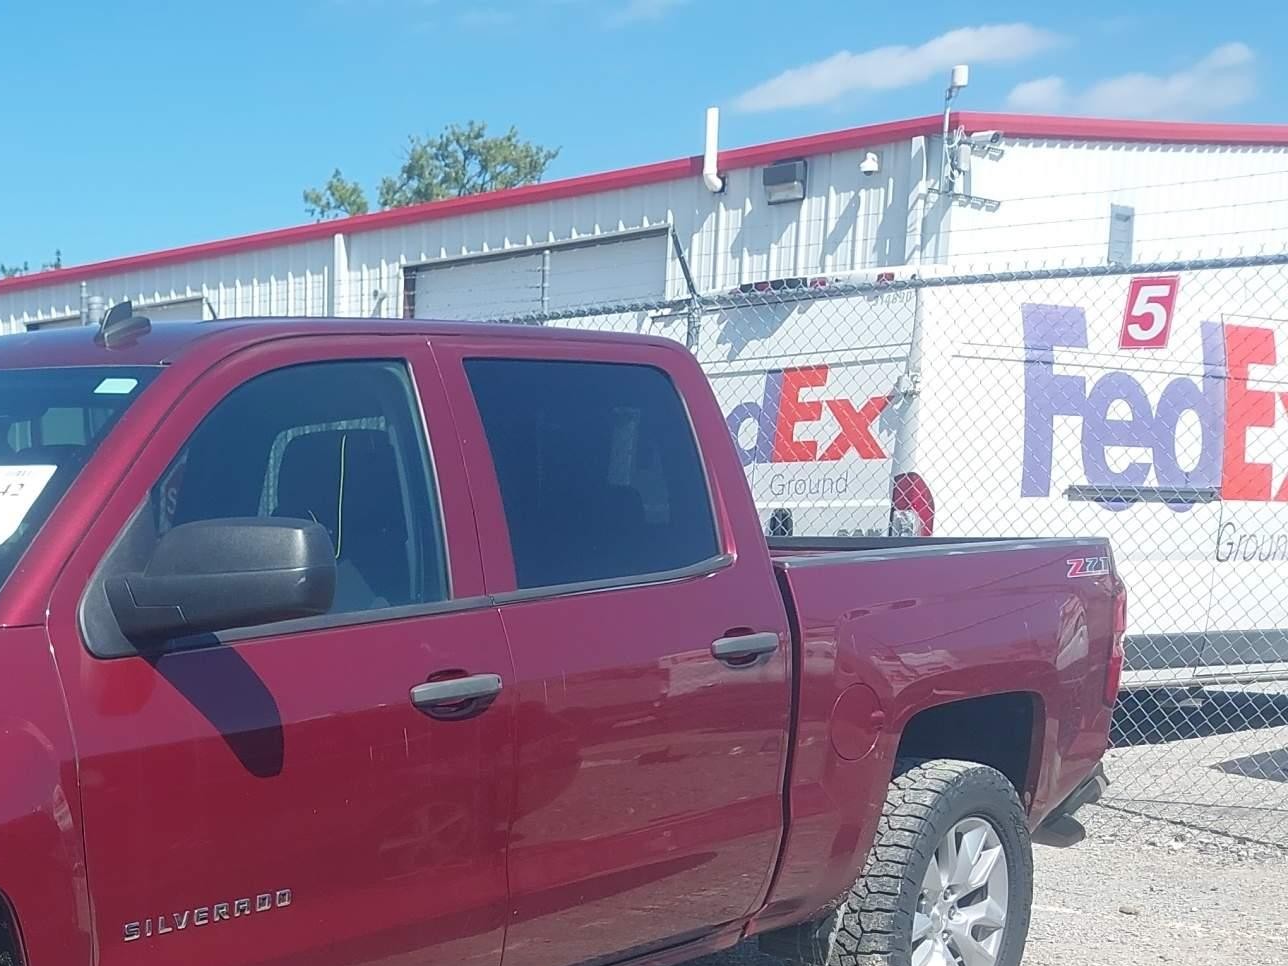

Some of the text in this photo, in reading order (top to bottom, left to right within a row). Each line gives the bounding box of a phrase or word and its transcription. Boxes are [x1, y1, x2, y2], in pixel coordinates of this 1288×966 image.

[1127, 285, 1170, 341] 5
[726, 364, 893, 467] dEx
[1021, 303, 1288, 513] FedE
[770, 473, 849, 496] Ground
[1066, 556, 1110, 578] Z71
[1216, 522, 1288, 562] Groun
[124, 889, 293, 941] SILVERADO
